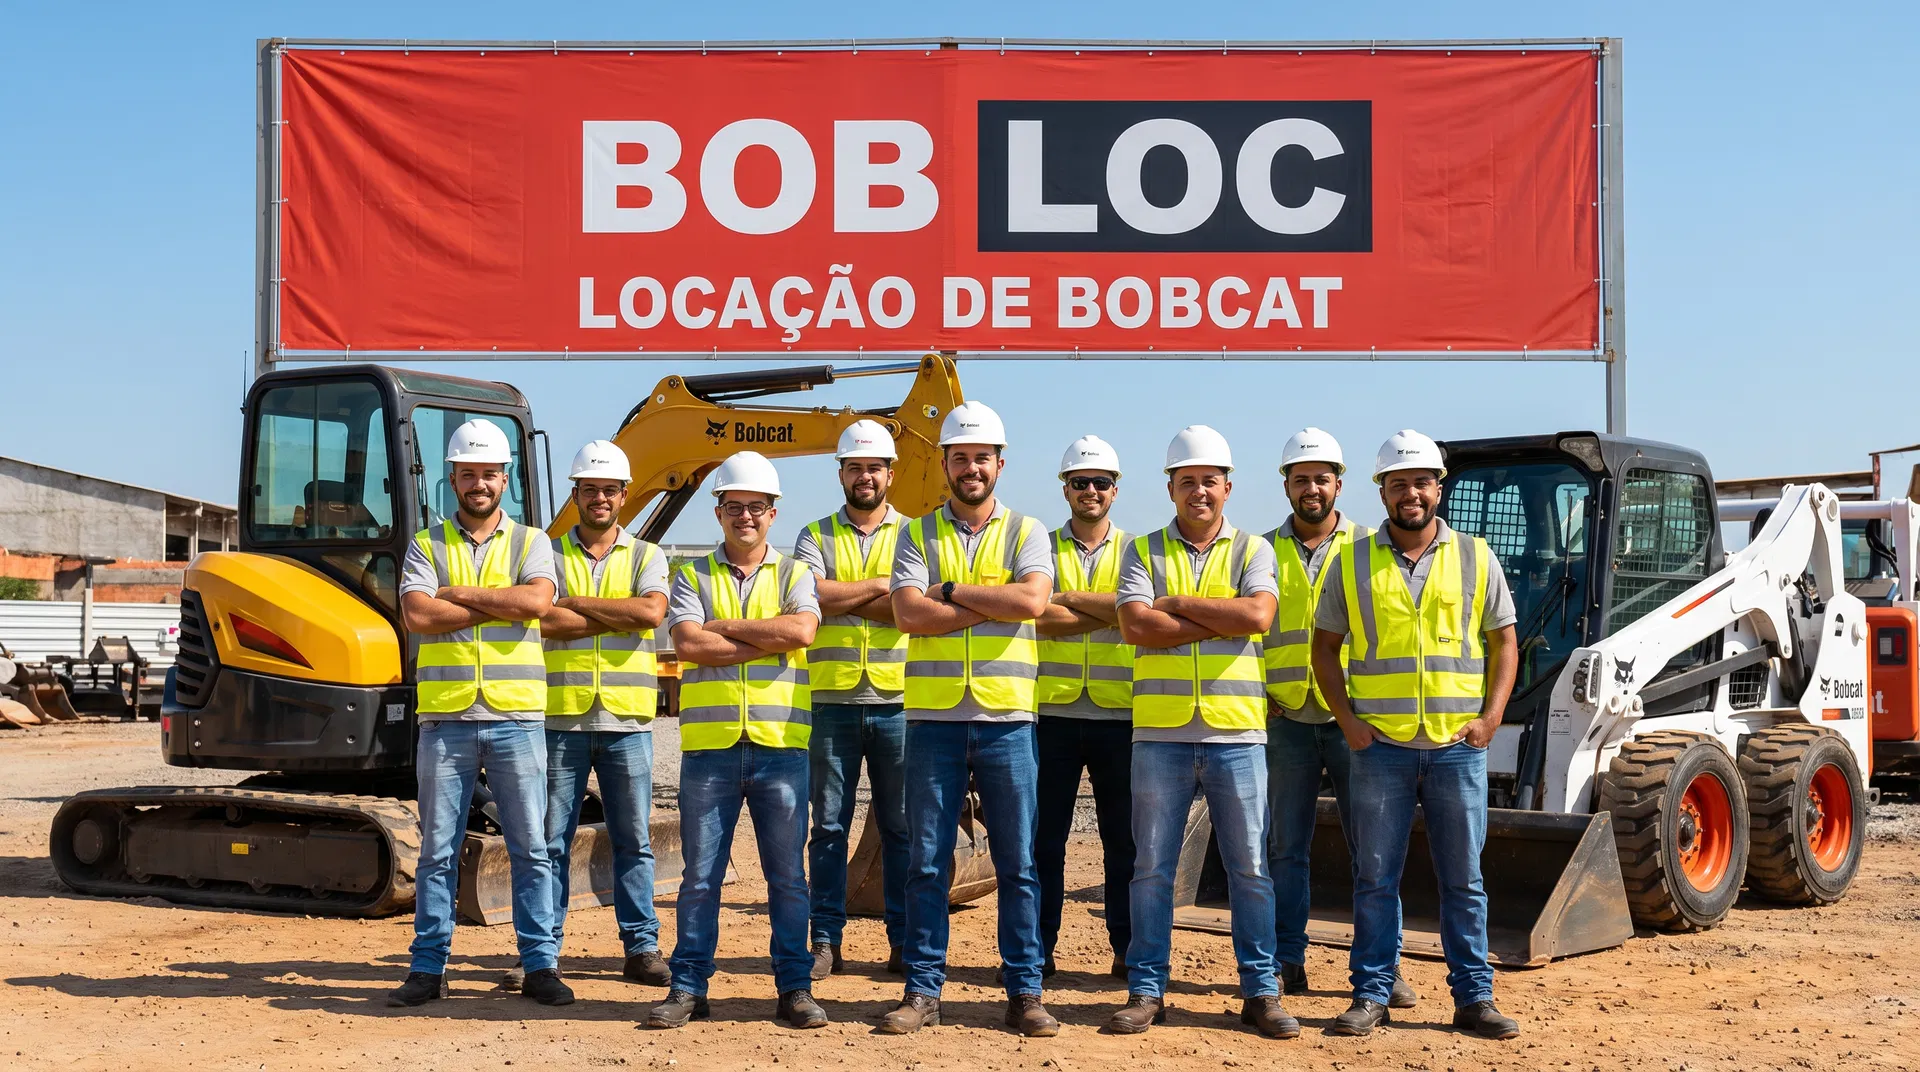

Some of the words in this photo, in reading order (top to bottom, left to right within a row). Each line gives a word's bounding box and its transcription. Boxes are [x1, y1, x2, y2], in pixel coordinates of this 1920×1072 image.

[582, 119, 940, 235] BOB
[1007, 118, 1347, 235] LOC
[579, 263, 916, 343] LOCAÇÃO
[943, 276, 1032, 329] DE
[1057, 276, 1343, 329] BOBCAT
[734, 422, 794, 443] Bobcat
[1833, 679, 1863, 699] Bobcat
